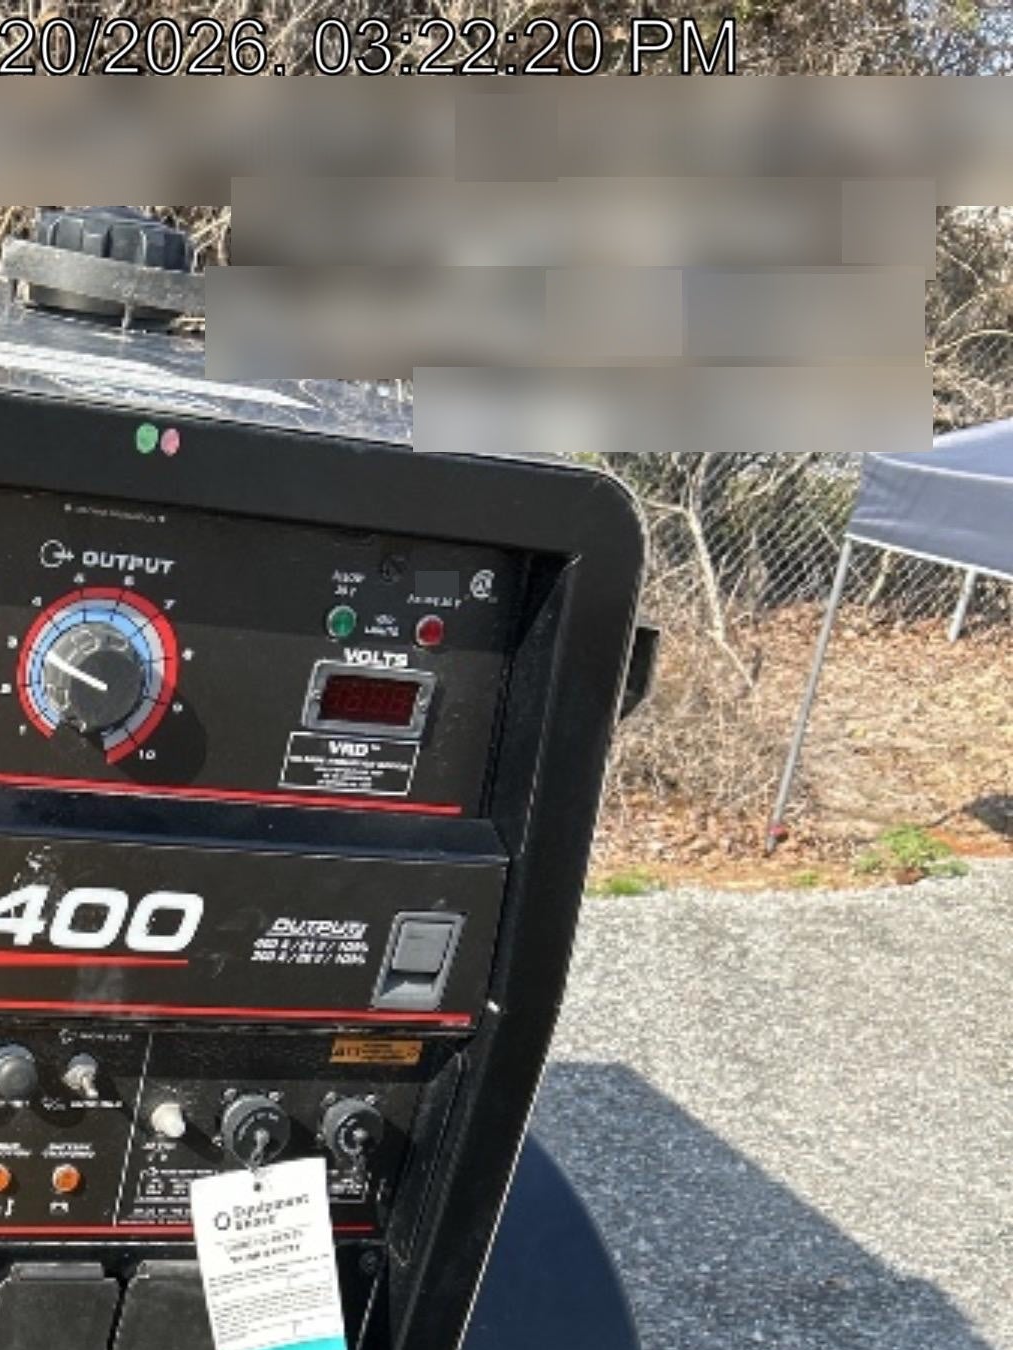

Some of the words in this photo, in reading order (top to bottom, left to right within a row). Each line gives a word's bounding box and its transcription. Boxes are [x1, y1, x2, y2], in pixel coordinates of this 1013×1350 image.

[82, 550, 175, 575] OUTPUT
[343, 648, 408, 668] VOLTS
[138, 749, 156, 761] 10
